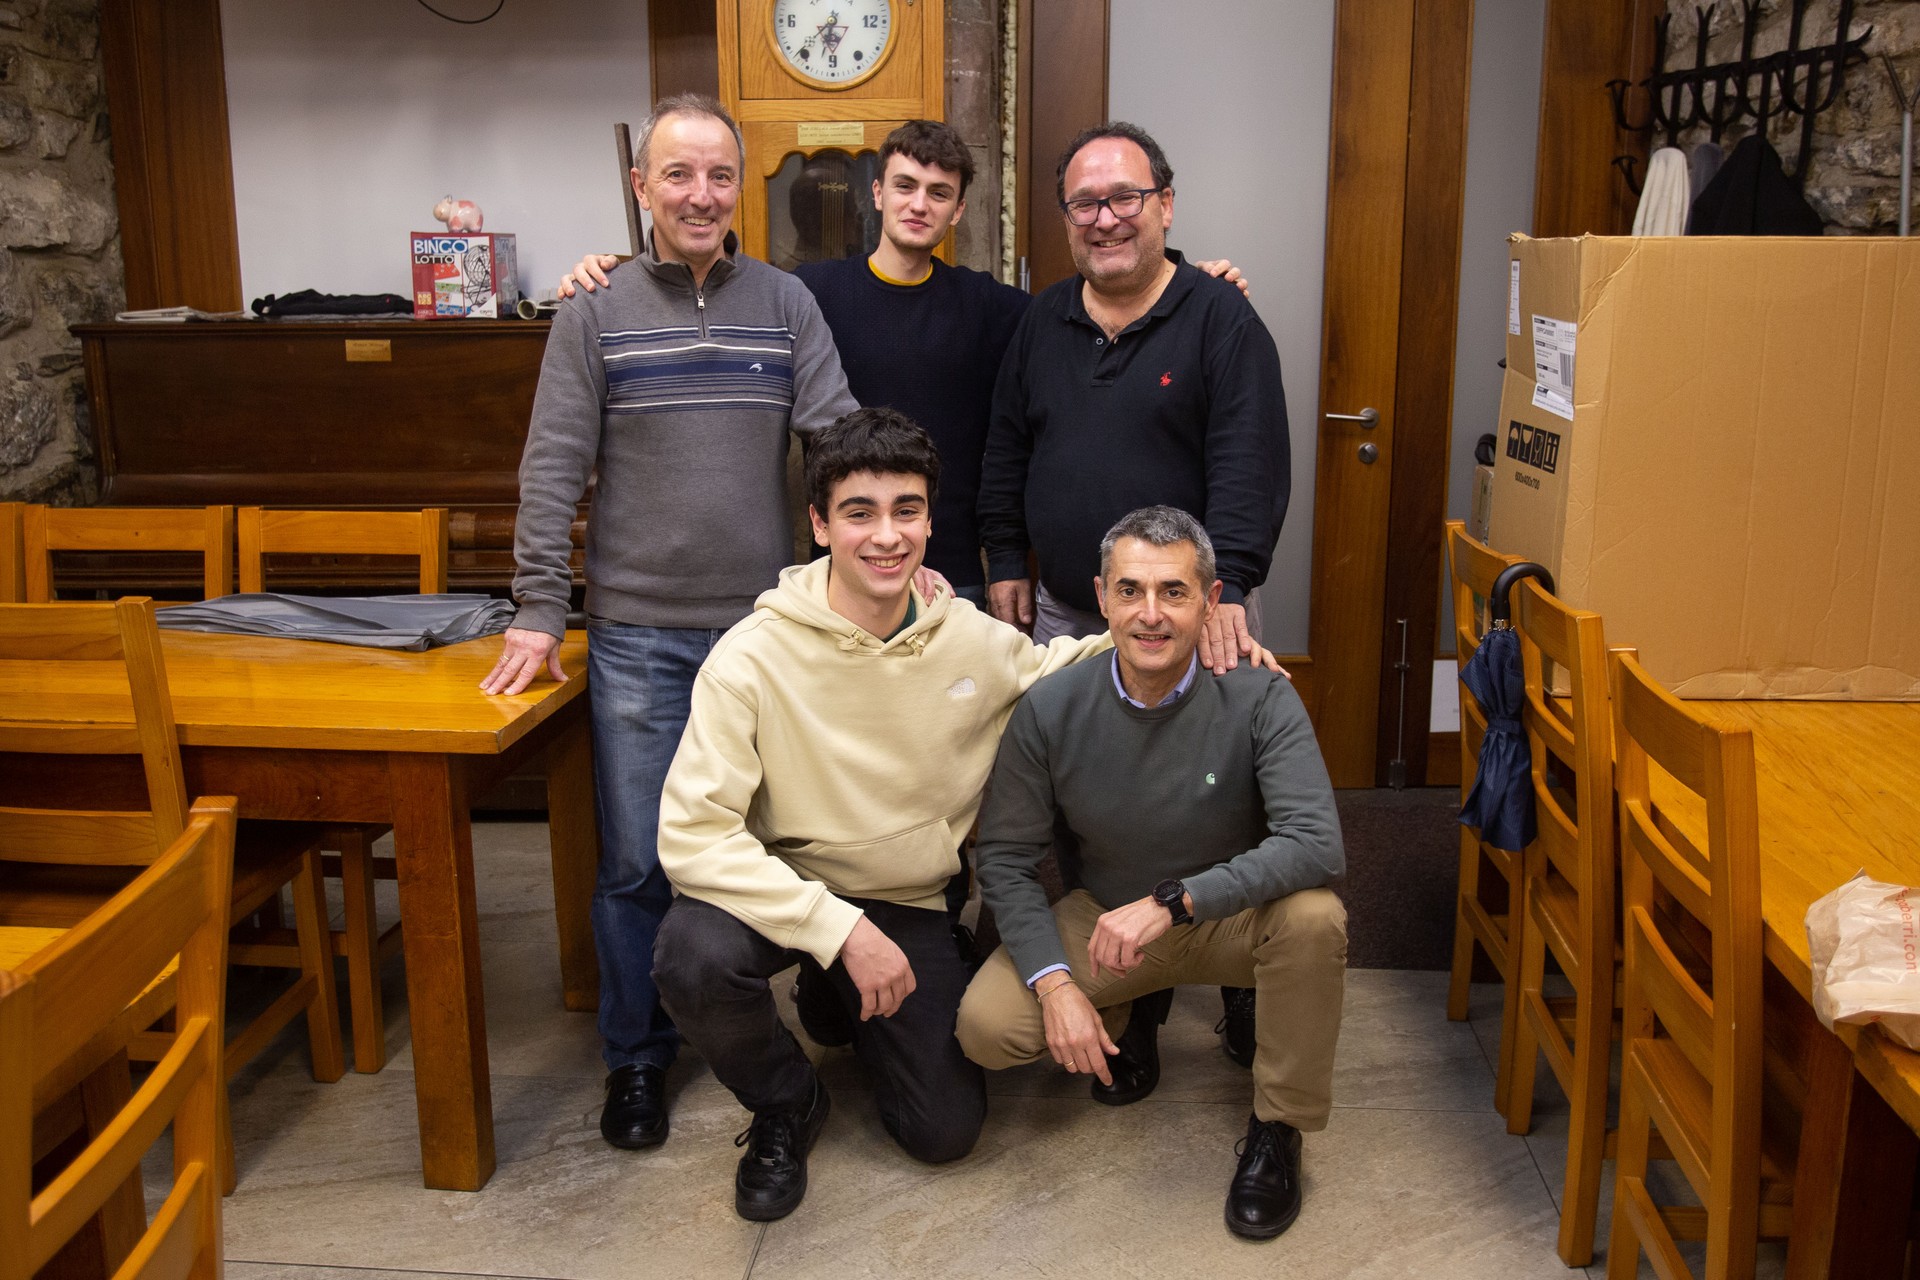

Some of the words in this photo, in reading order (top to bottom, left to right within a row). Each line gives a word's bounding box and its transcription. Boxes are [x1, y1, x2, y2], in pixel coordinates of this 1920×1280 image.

[787, 14, 796, 28] 6
[863, 15, 878, 28] 12
[828, 55, 837, 68] 9
[414, 239, 468, 254] BINGO
[415, 255, 454, 264] LOTTO
